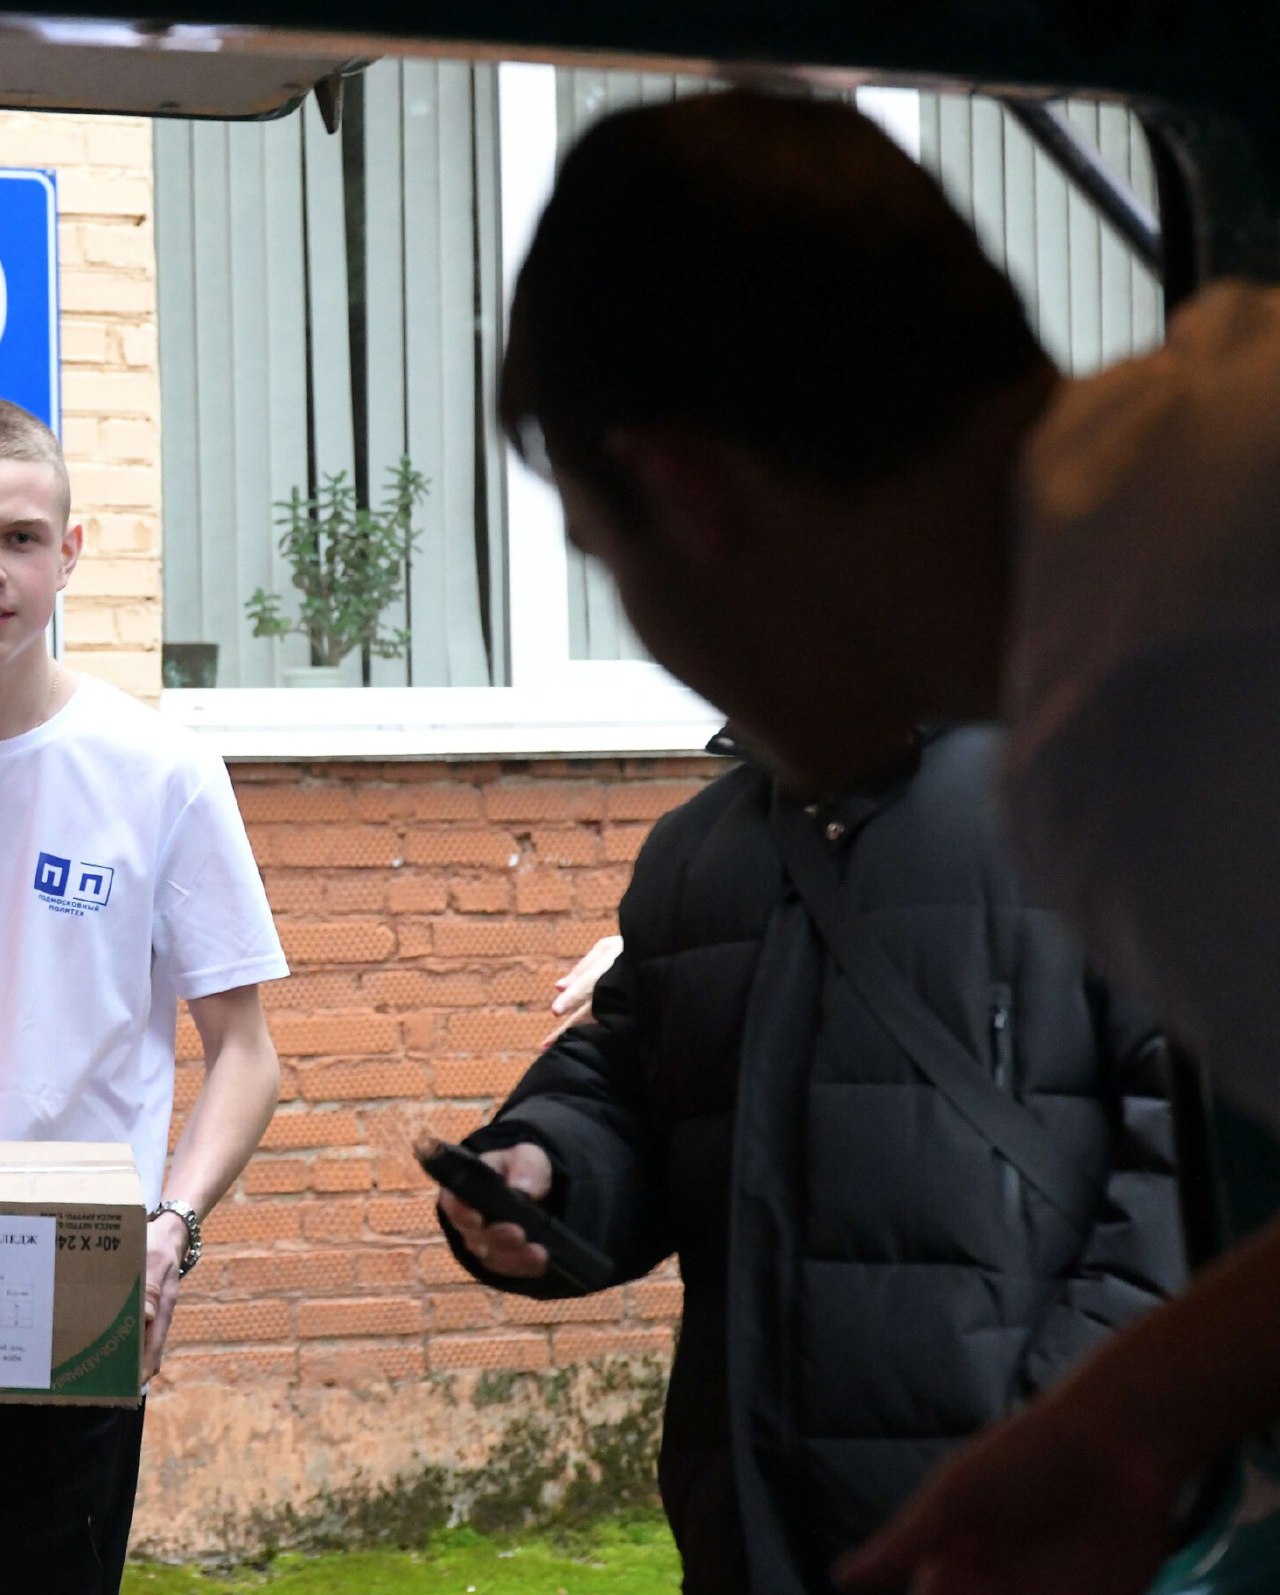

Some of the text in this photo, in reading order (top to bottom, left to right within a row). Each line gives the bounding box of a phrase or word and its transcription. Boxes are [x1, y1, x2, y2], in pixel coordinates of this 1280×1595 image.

[38, 894, 99, 911] ПОДМОСКОВНЫЙ
[48, 904, 84, 916] ПОЛИТЕХ
[80, 1235, 91, 1252] Х
[96, 1235, 121, 1252] 40г
